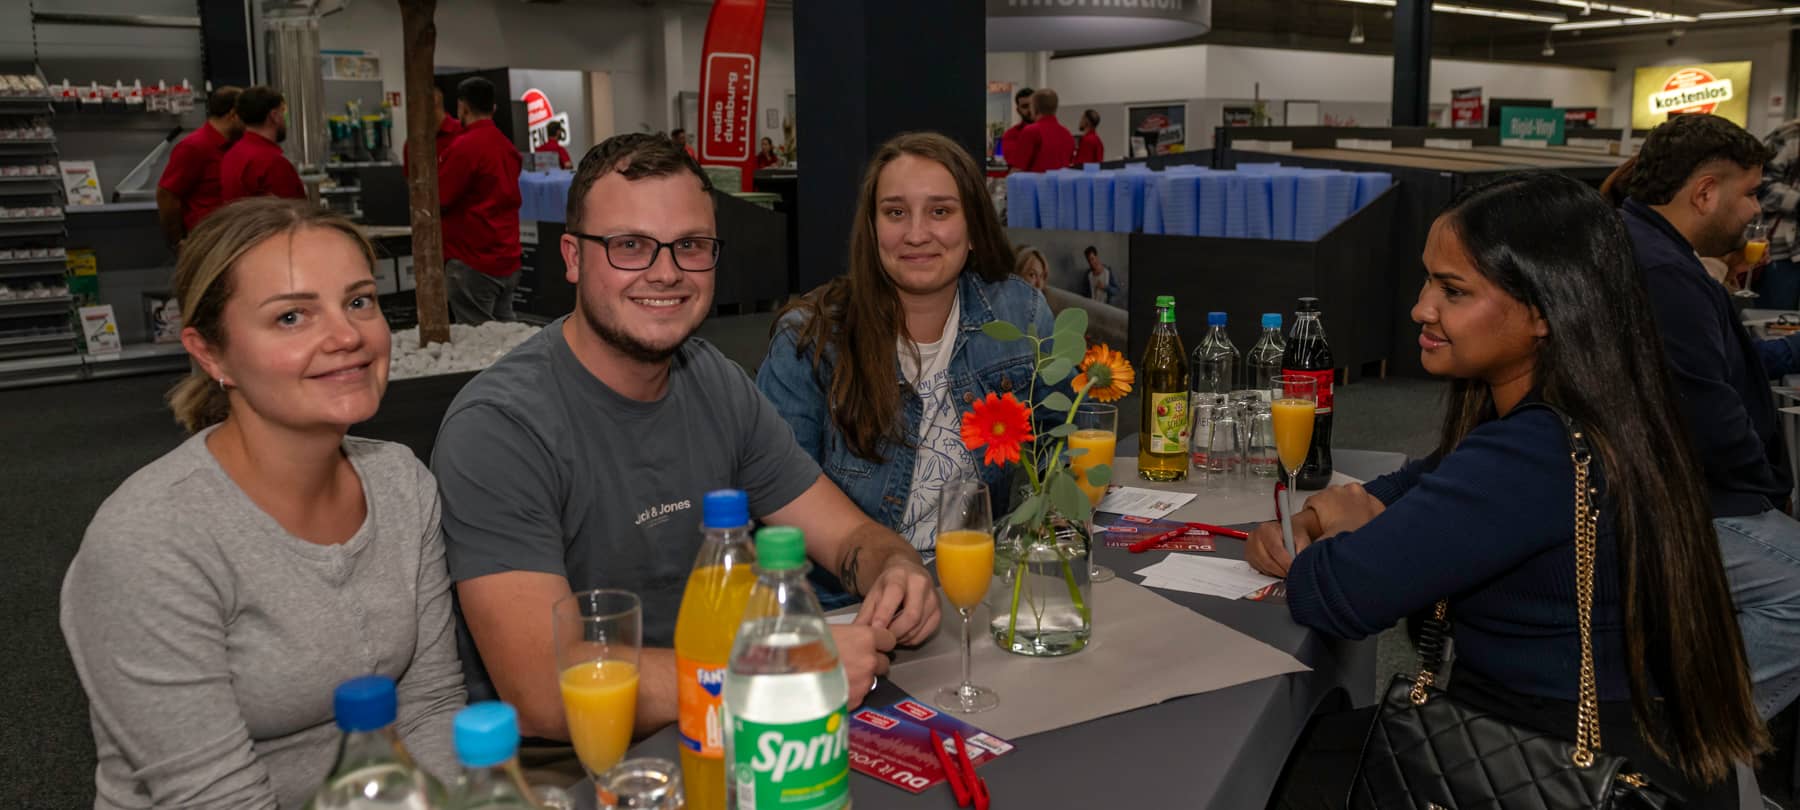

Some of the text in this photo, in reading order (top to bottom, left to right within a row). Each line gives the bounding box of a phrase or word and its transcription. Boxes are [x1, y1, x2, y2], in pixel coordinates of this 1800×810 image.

[723, 71, 739, 144] duisburg
[1655, 86, 1728, 109] kostenlos
[712, 101, 724, 143] radio
[651, 506, 658, 518] &
[659, 499, 691, 515] Jones
[696, 667, 727, 685] FANT
[751, 715, 848, 783] Sprit
[878, 763, 895, 775] it
[892, 770, 930, 788] DU
